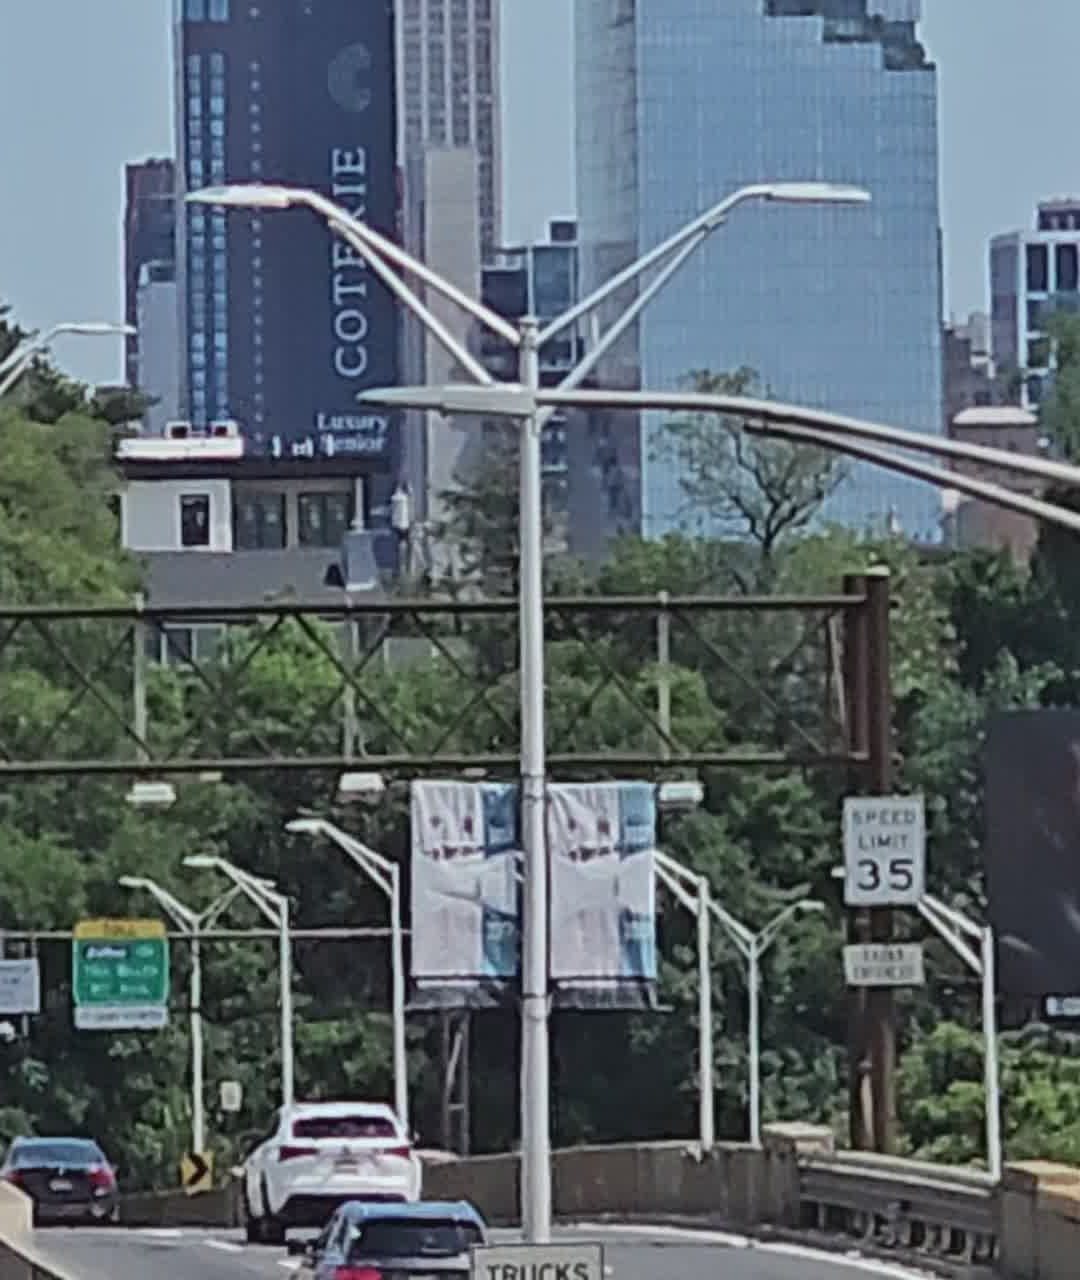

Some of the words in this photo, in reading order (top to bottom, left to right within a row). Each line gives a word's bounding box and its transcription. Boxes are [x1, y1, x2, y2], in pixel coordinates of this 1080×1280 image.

[317, 413, 388, 432] Luxury
[852, 810, 916, 825] SPEED
[858, 833, 909, 850] LIMIT
[857, 858, 914, 891] 35
